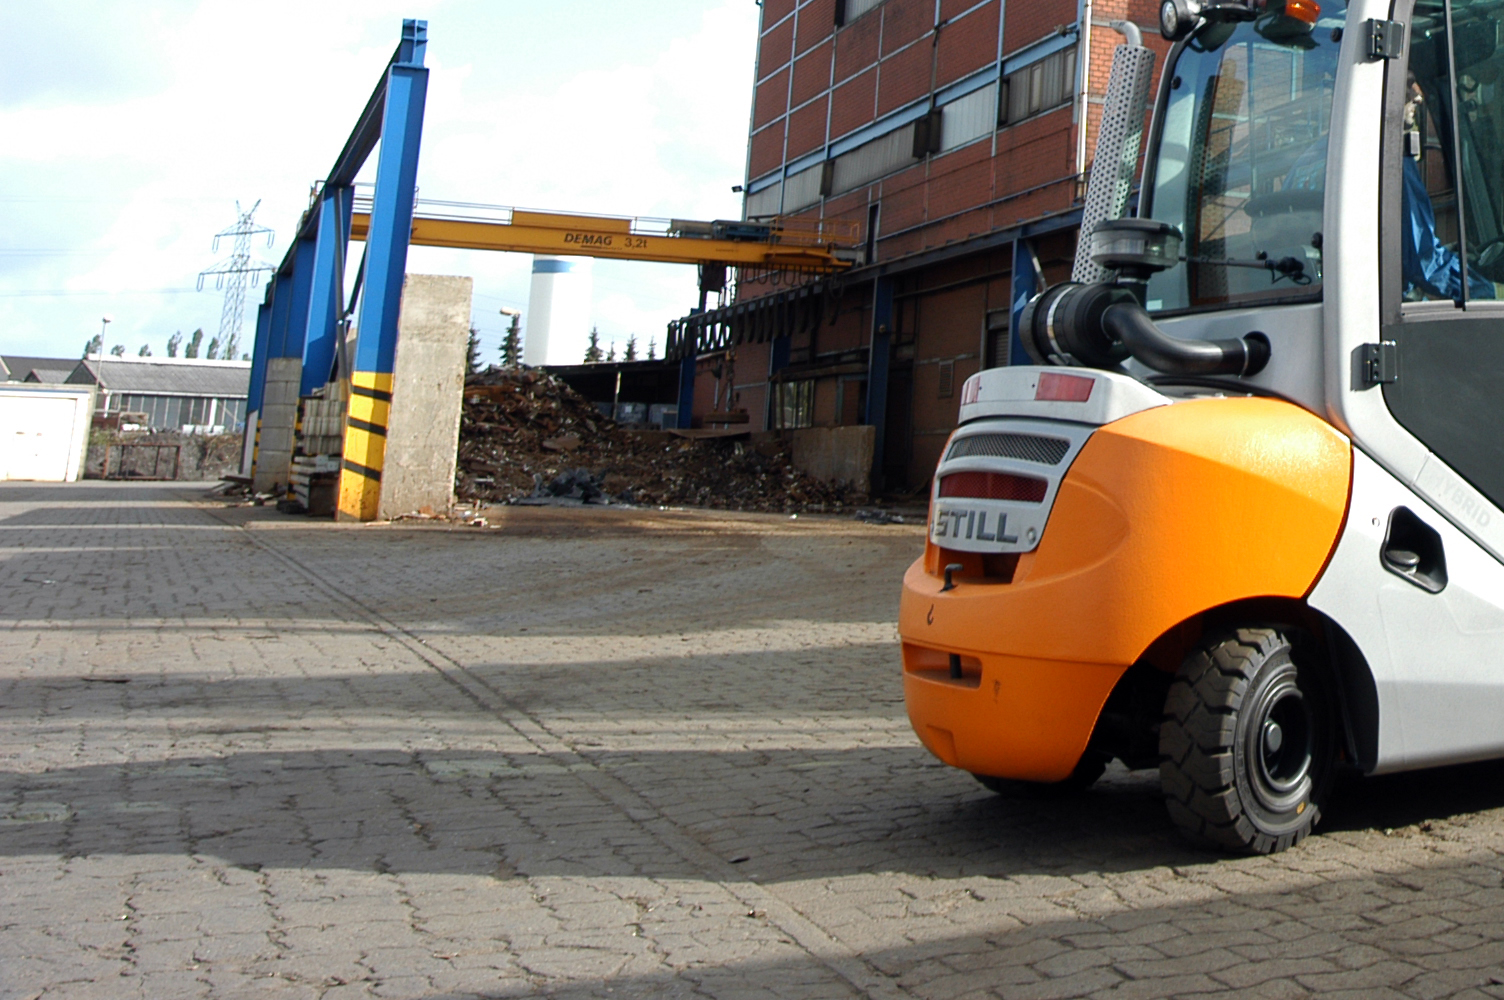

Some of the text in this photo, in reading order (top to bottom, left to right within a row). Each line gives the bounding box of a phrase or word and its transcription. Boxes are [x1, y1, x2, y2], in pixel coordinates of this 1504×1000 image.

[564, 233, 612, 246] DEMAG
[625, 238, 648, 249] 3,2t
[935, 510, 1018, 544] STILL
